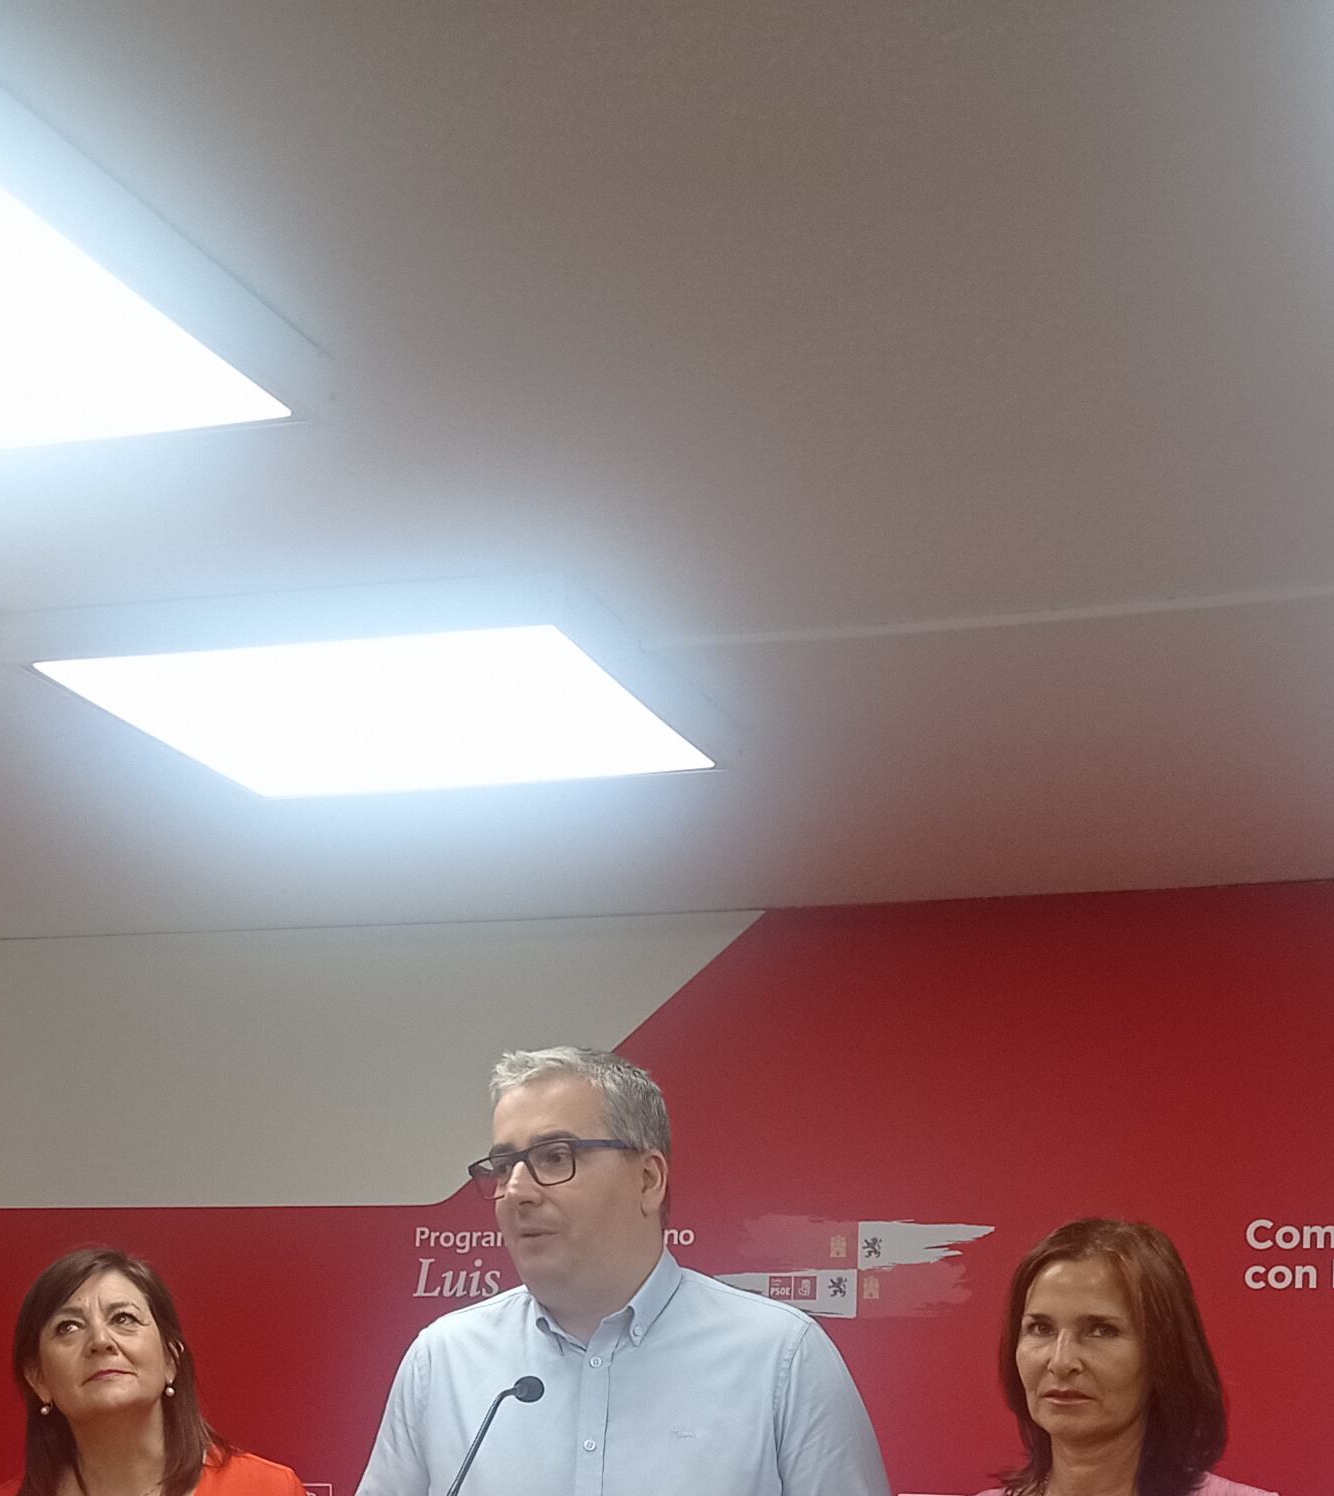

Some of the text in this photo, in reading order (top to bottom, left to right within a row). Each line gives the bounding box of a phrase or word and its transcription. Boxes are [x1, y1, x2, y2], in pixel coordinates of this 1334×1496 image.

[415, 1227, 503, 1254] Progra
[413, 1258, 501, 1297] Luis
[1244, 1265, 1318, 1290] con
